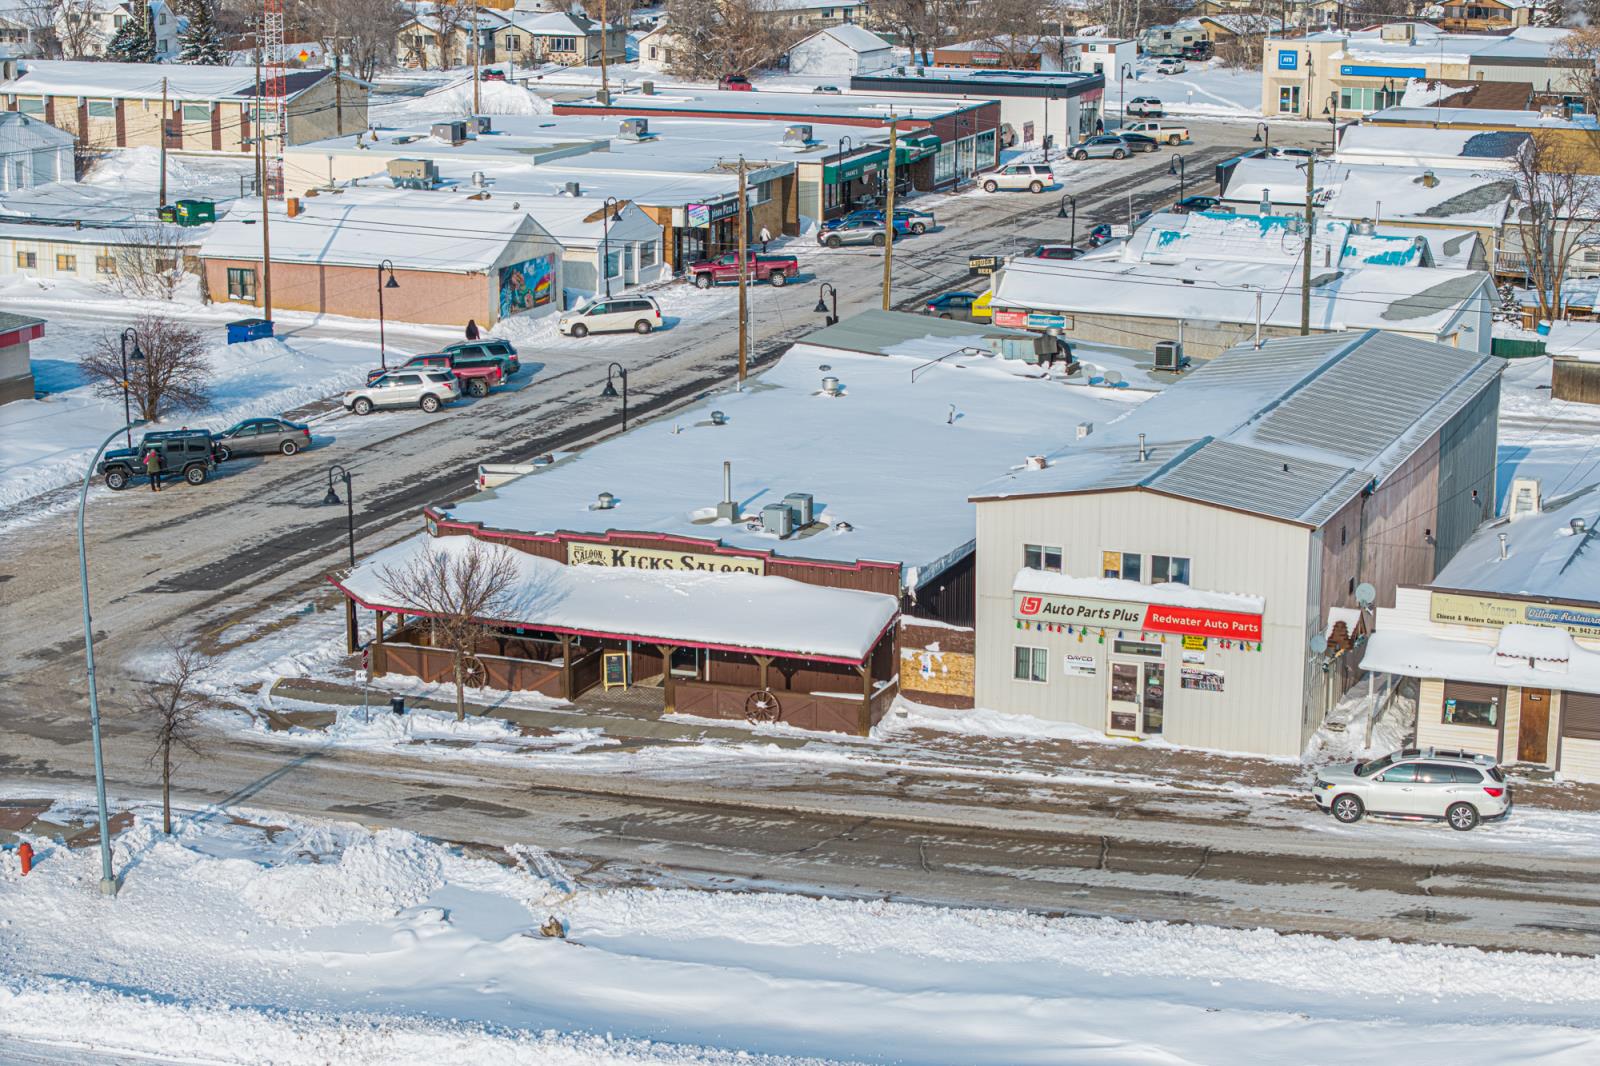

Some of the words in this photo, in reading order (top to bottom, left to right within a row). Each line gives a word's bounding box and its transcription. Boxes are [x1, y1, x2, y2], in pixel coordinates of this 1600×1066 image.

[970, 258, 995, 268] LIQUOR
[611, 548, 673, 570] KICKS
[1042, 601, 1075, 616] Auto
[1076, 603, 1110, 619] Parts
[1112, 606, 1140, 623] Plus
[1436, 612, 1456, 621] Chinese
[1464, 615, 1485, 623] Western
[1486, 617, 1505, 625] Cuisine
[1152, 613, 1202, 627] Redwater
[1204, 618, 1229, 630] Auto
[1232, 620, 1259, 633] Parts
[1066, 654, 1093, 662] DAYCO
